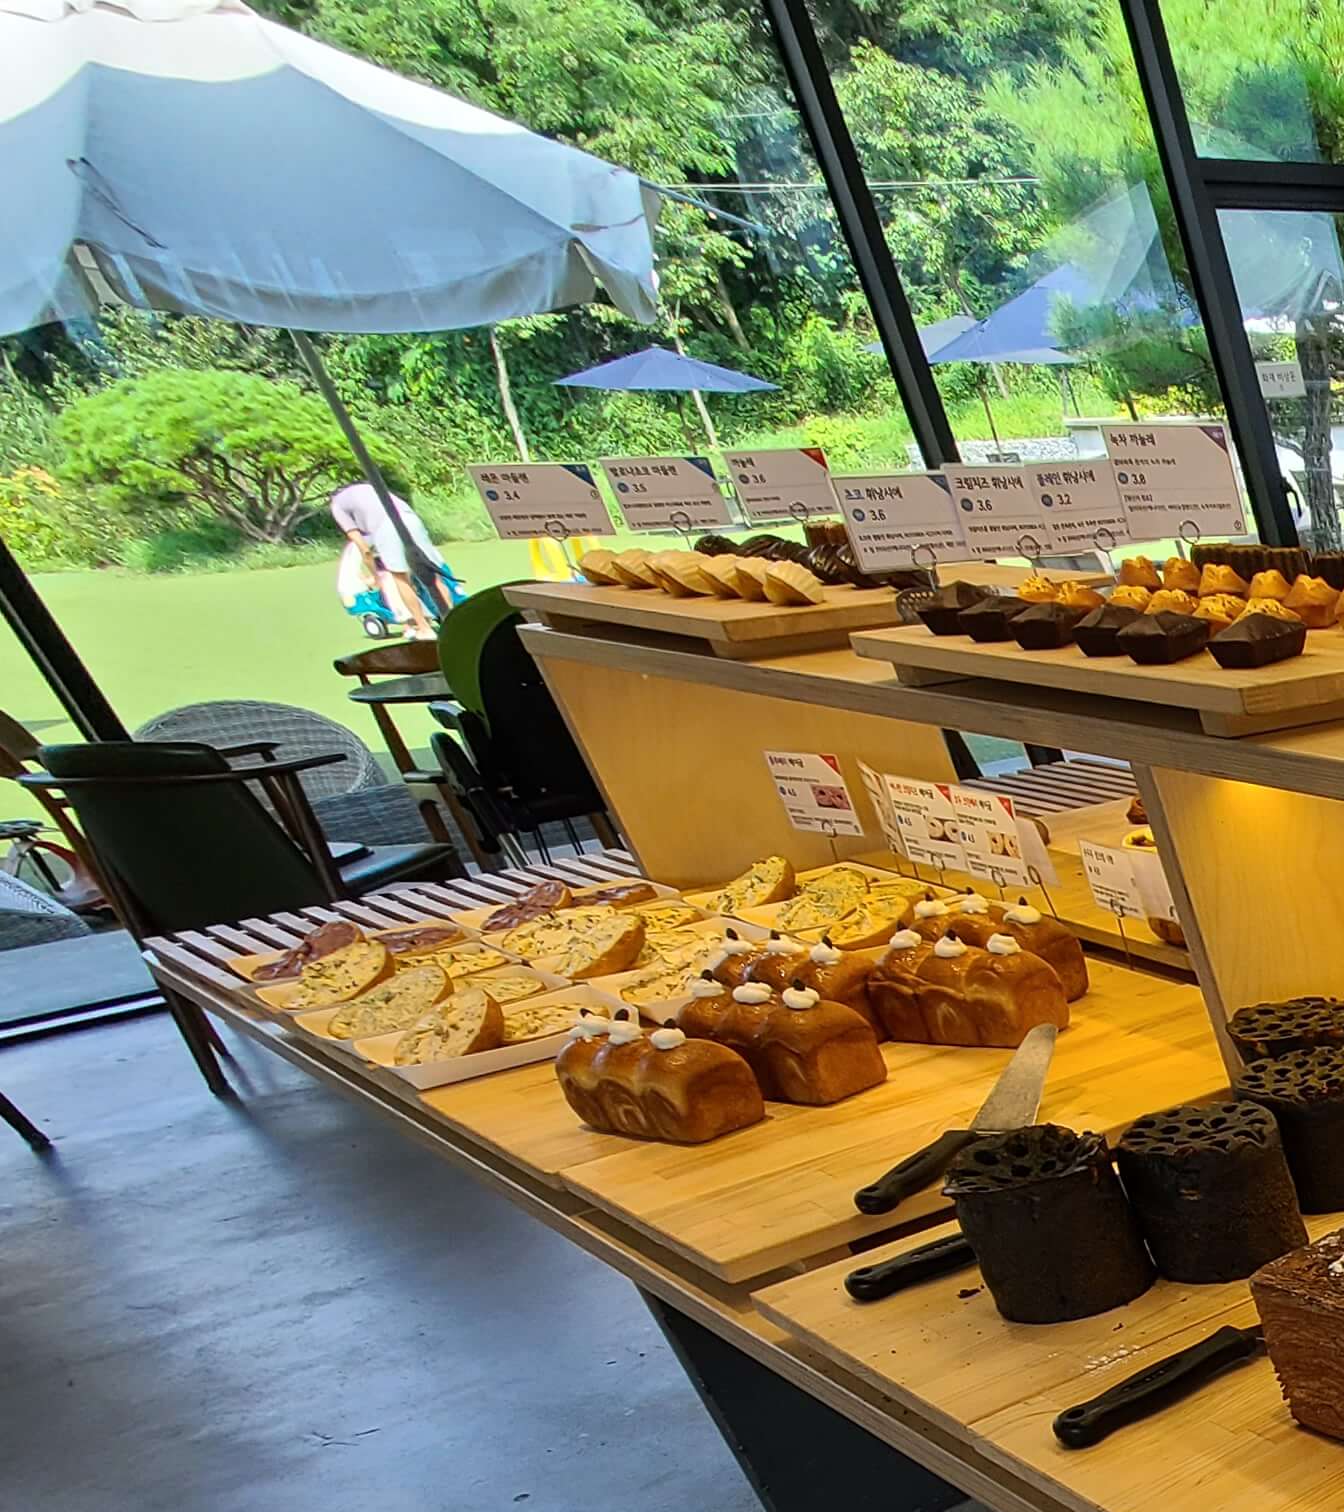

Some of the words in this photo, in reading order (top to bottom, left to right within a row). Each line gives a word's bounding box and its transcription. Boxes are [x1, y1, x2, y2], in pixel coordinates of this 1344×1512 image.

[976, 499, 993, 511] 3.6
[1056, 493, 1072, 505] 3.2
[869, 509, 886, 520] 3.6
